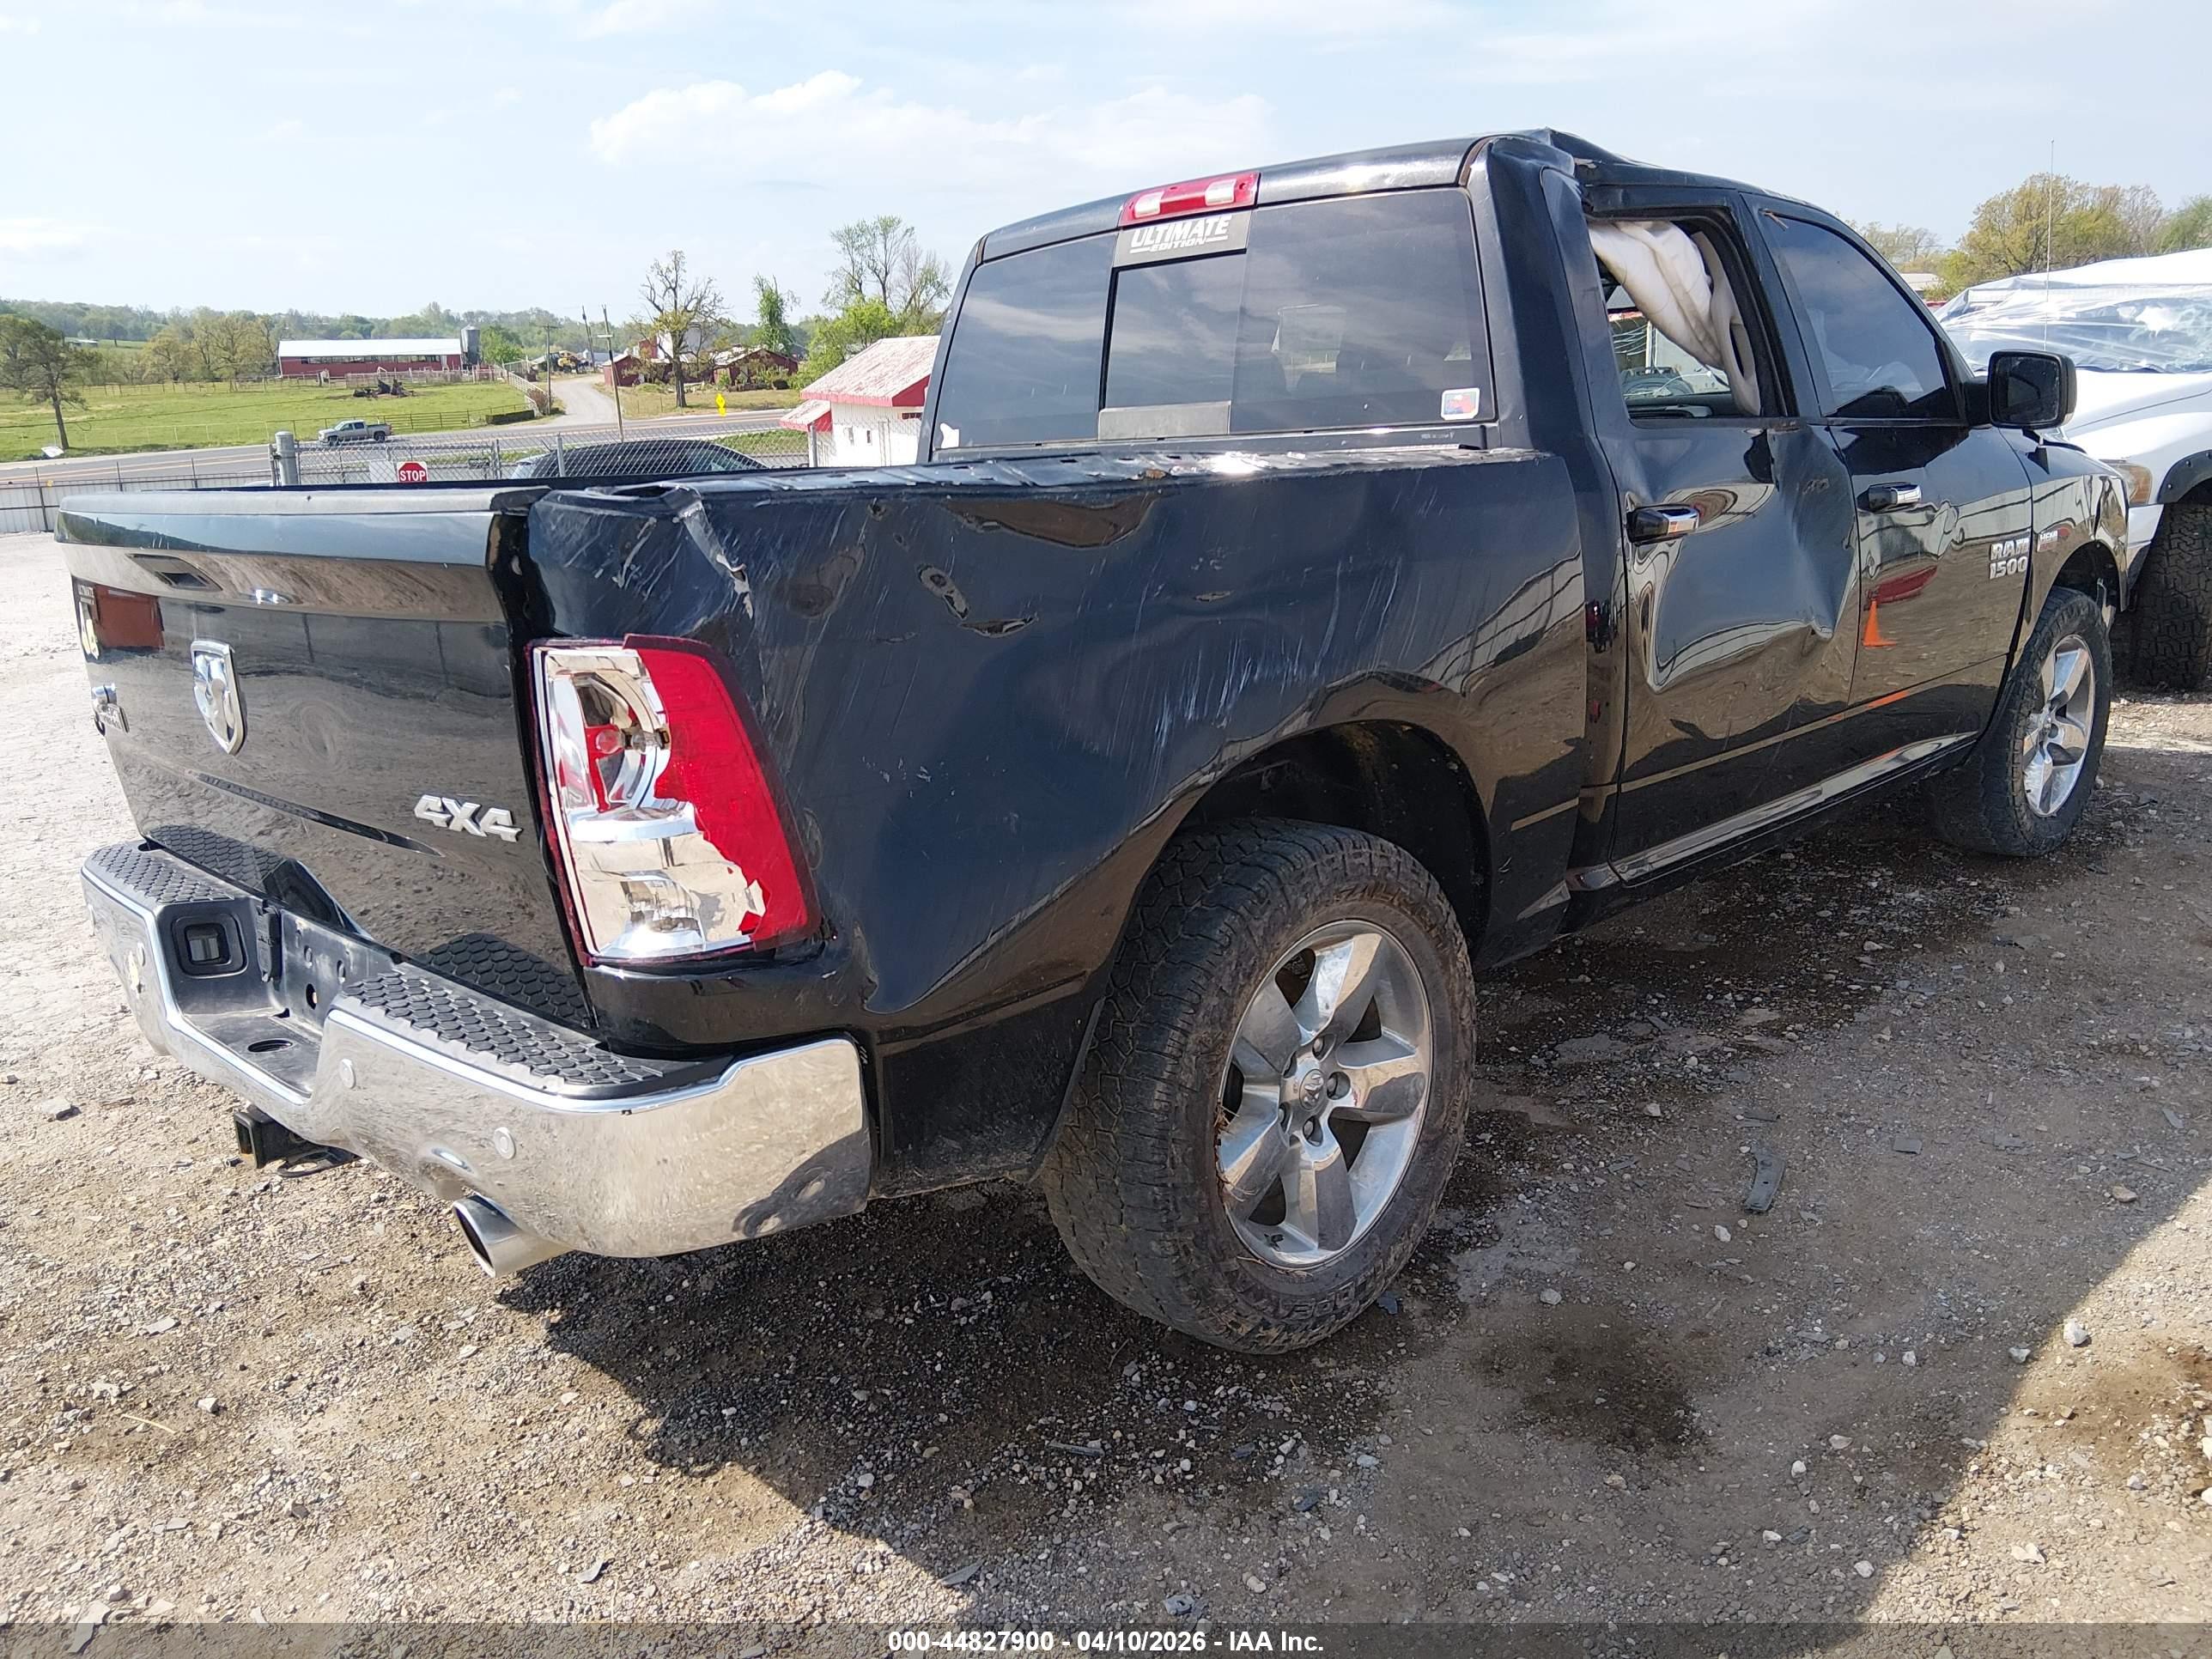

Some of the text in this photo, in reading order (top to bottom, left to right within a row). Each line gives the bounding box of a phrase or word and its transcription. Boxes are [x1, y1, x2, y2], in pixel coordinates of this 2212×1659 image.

[1130, 214, 1233, 248] ULTIMATE
[1151, 237, 1206, 252] EDITION
[399, 470, 426, 482] STOP
[1990, 538, 2030, 561] RAM
[1989, 556, 2028, 580] 1500
